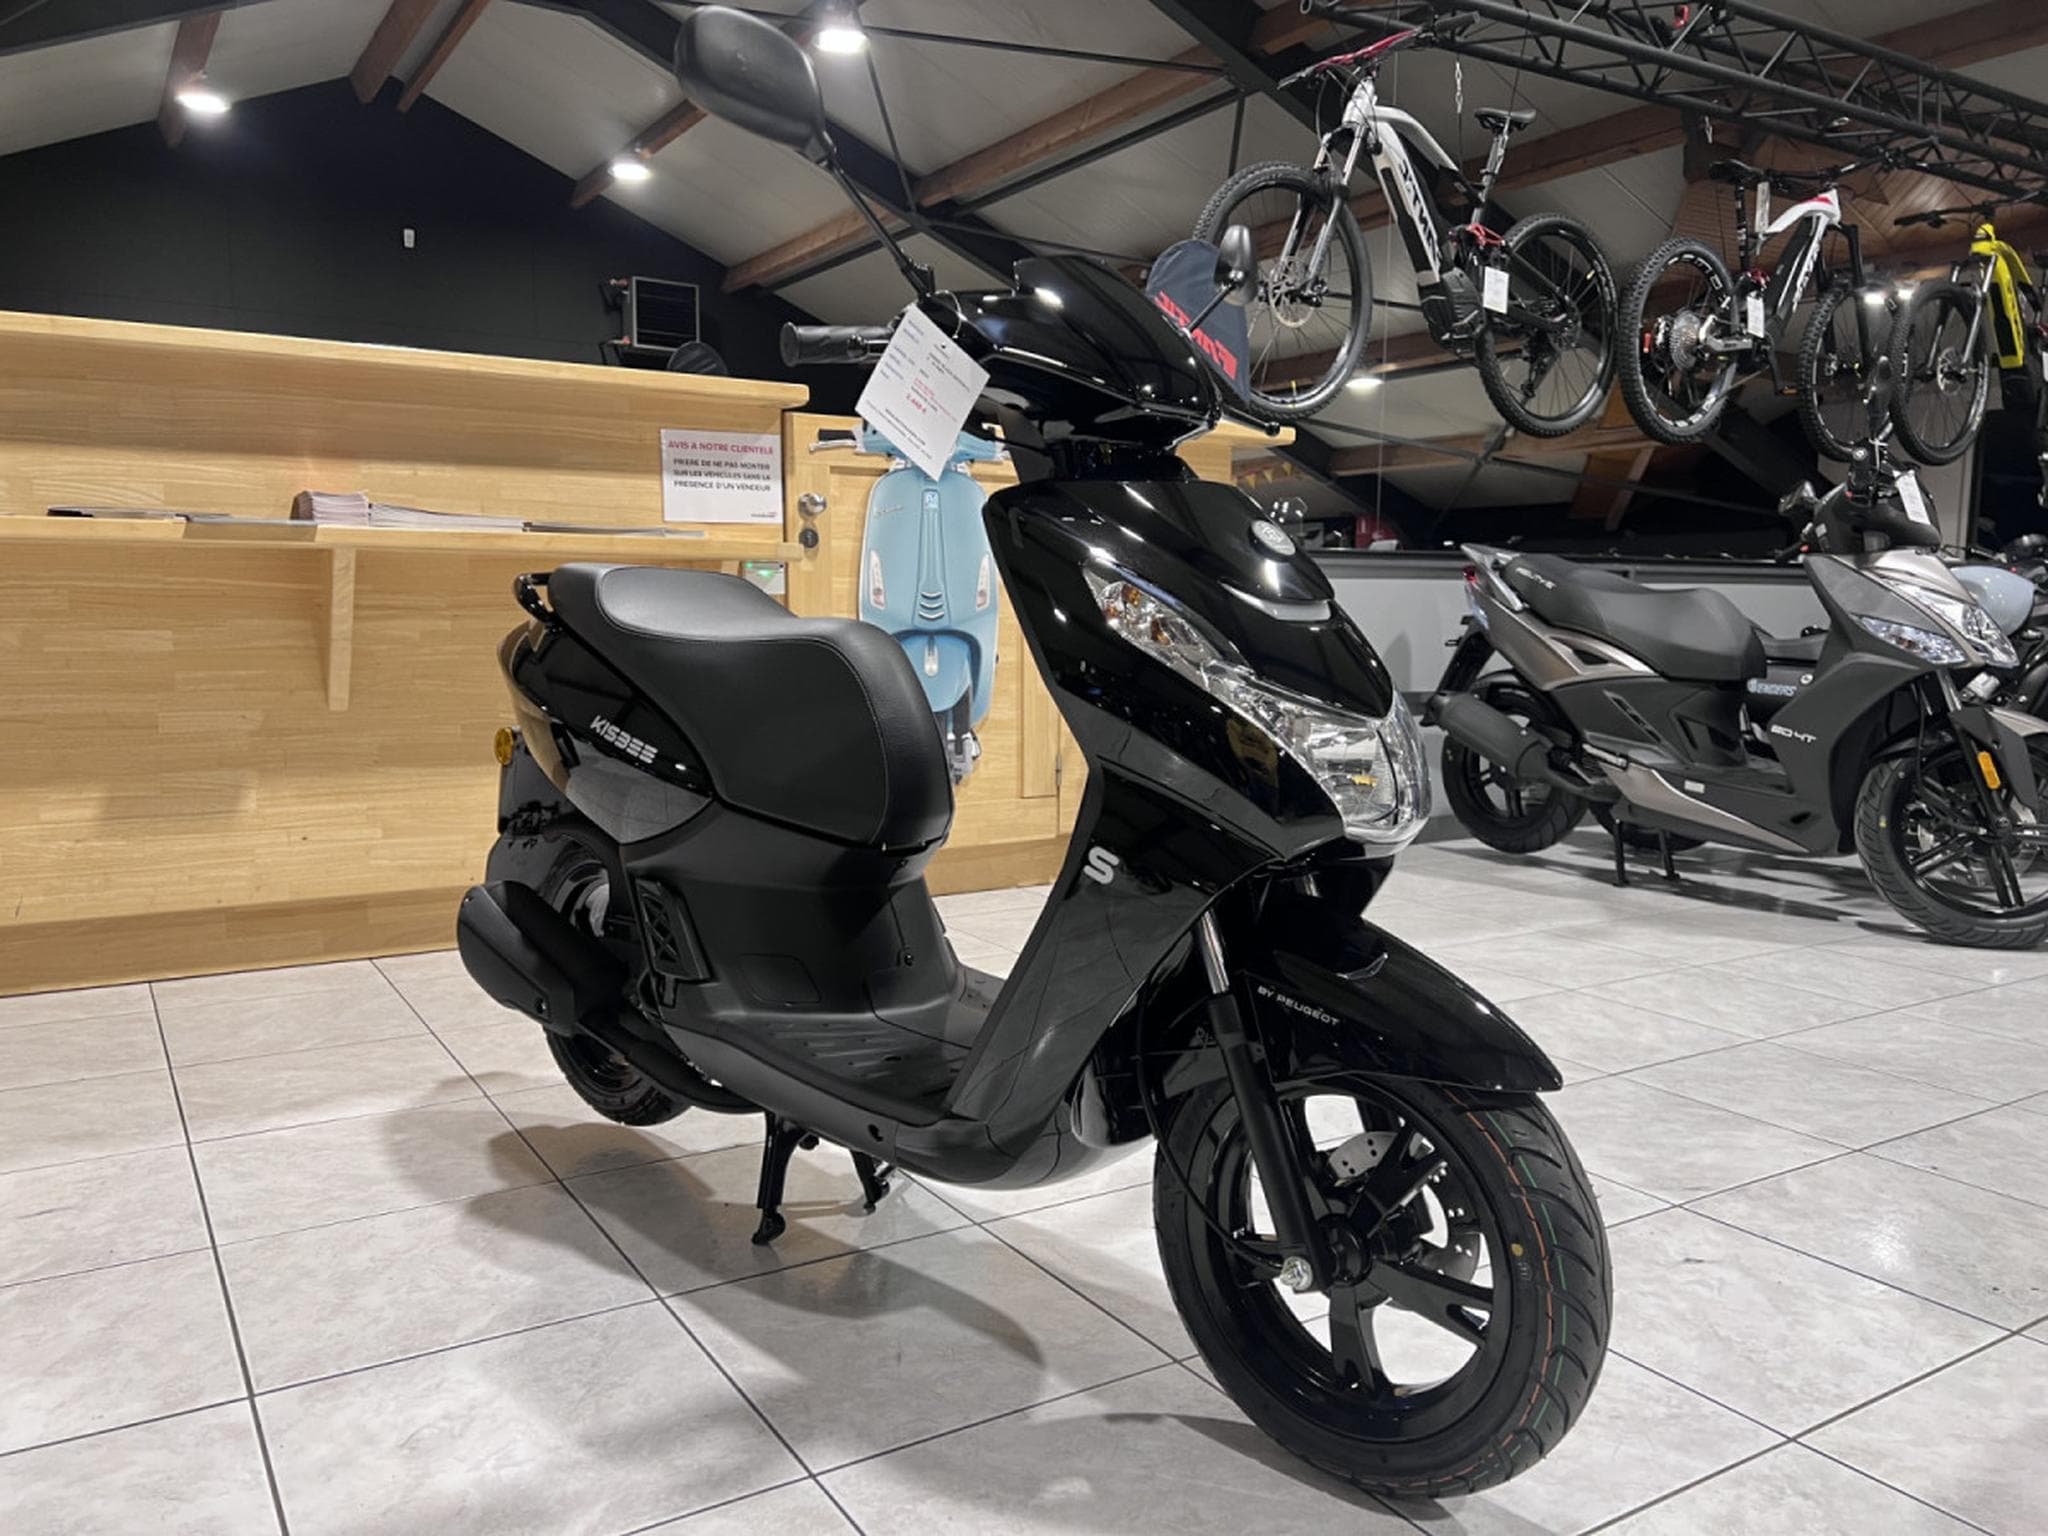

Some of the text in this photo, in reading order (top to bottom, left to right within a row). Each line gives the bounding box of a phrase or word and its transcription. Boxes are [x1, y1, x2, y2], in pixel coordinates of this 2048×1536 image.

[668, 440, 689, 449] AVIS
[691, 441, 697, 450] A
[699, 442, 729, 452] NOTRE
[701, 459, 711, 467] DE
[713, 460, 723, 468] NE
[724, 461, 738, 469] PAS
[740, 462, 770, 470] MONTER
[673, 469, 688, 477] SUR
[704, 471, 741, 479] VEHICULES
[743, 472, 760, 480] SANS
[762, 473, 771, 481] LA
[673, 480, 771, 492] PRESENCE D'UN VENDEUR
[590, 715, 659, 764] KISBEE
[1083, 845, 1120, 885] S
[1257, 985, 1340, 1026] BY PEUGEOT
